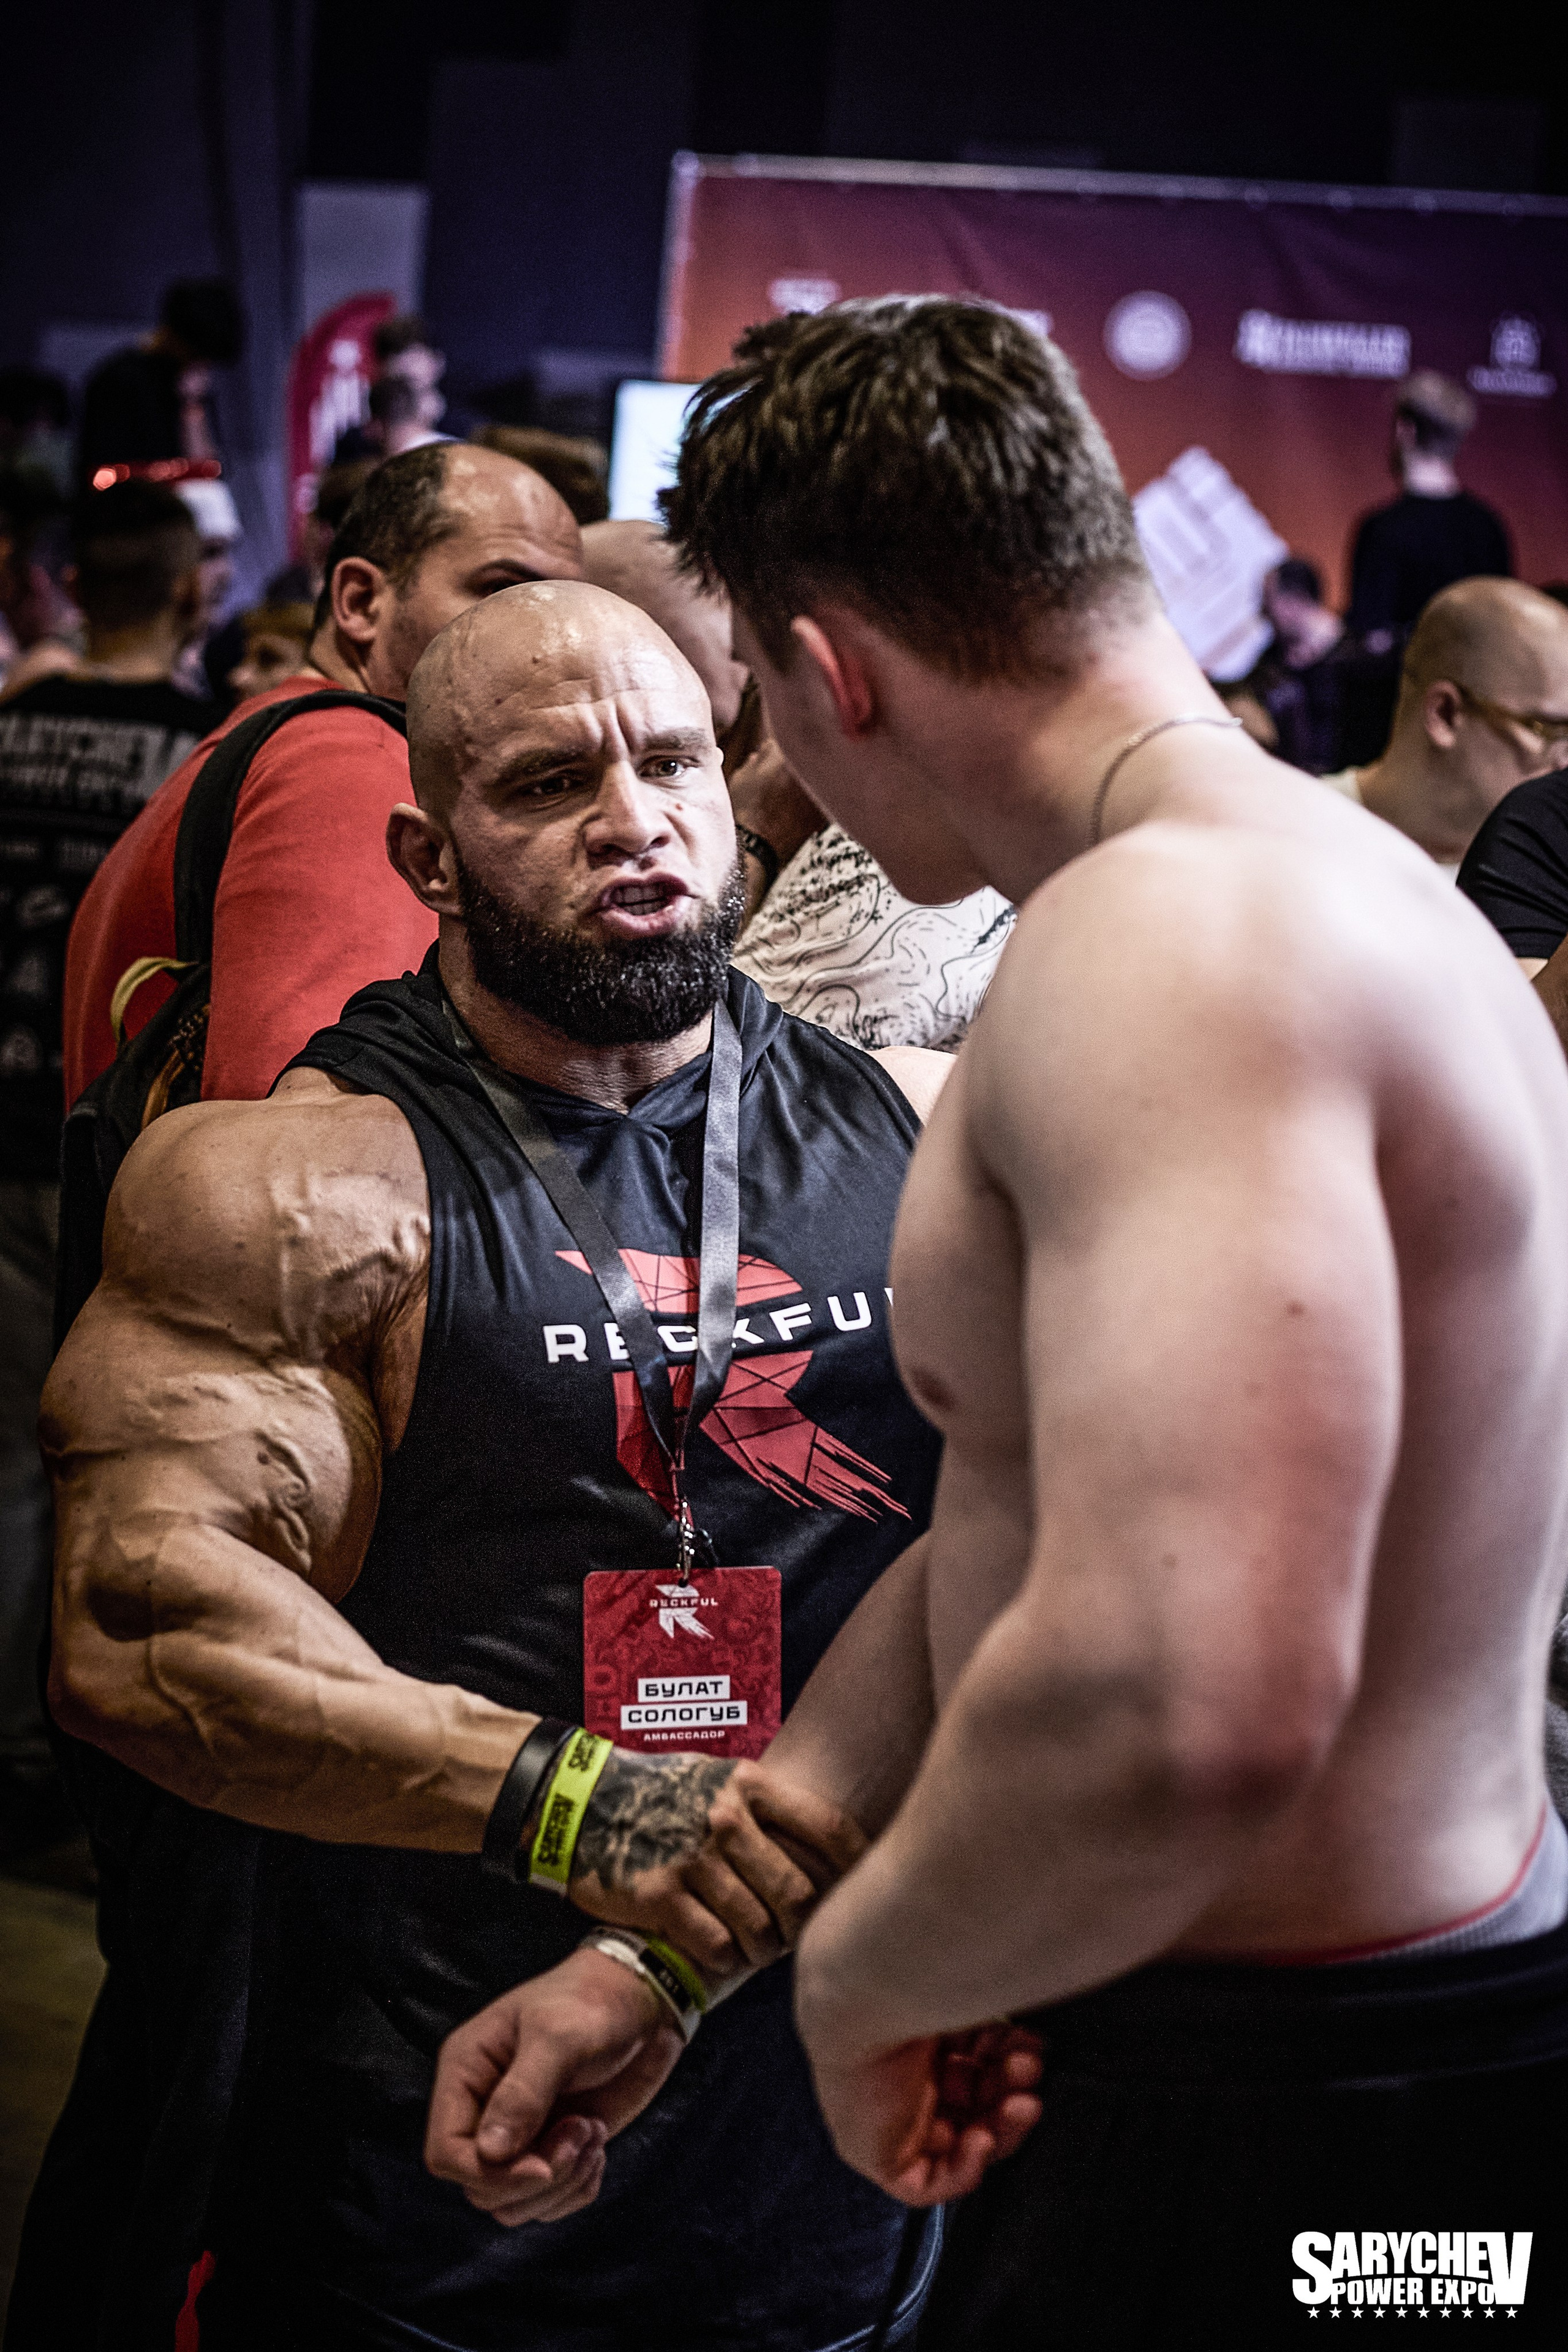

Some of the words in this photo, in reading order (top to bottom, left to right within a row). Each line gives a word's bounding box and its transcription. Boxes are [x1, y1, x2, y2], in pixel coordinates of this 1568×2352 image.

[543, 1287, 894, 1363] RECKFU
[649, 1597, 718, 1608] RECKFUL
[645, 1681, 723, 1697] БУЛАТ
[628, 1706, 741, 1724] СОЛОГУБ
[644, 1730, 726, 1742] АМБАССАДОР
